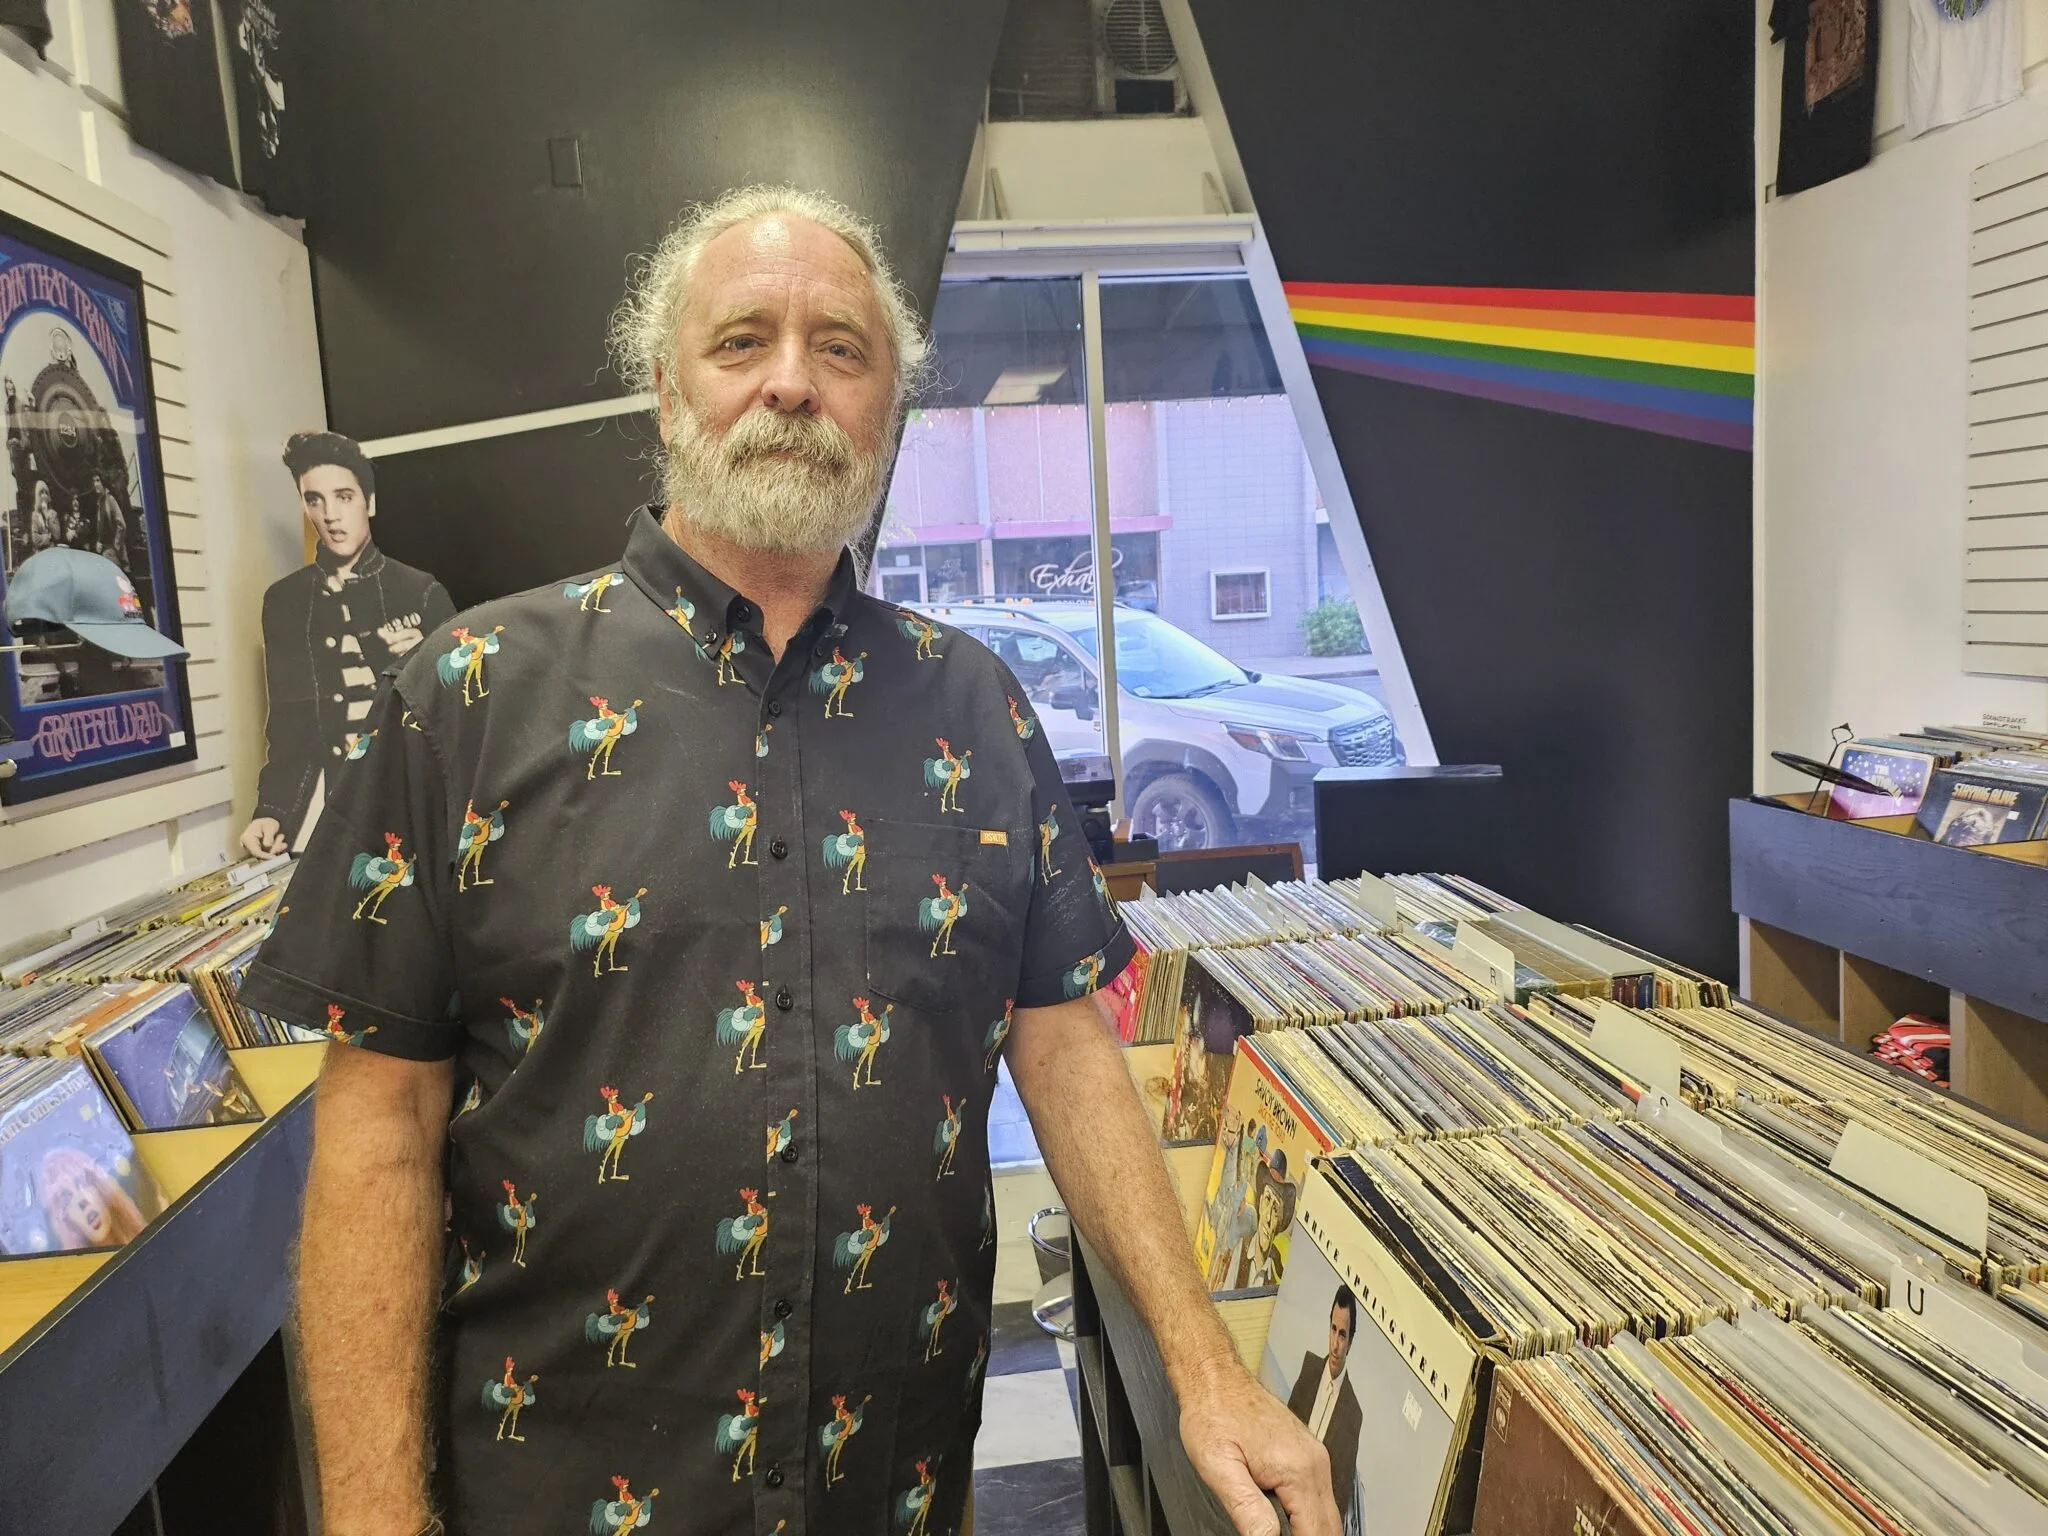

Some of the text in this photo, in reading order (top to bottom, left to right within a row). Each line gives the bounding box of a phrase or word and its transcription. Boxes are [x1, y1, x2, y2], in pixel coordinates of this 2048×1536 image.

[26, 262, 70, 312] THAT
[69, 279, 135, 398] TRAIN
[31, 701, 174, 762] GRATEFUL DEAD
[1489, 966, 1497, 986] R
[1255, 1078, 1298, 1140] SAVOY BROWN
[1304, 1209, 1451, 1402] BRUCE SPRINGSTEEN
[1907, 1280, 1925, 1316] U
